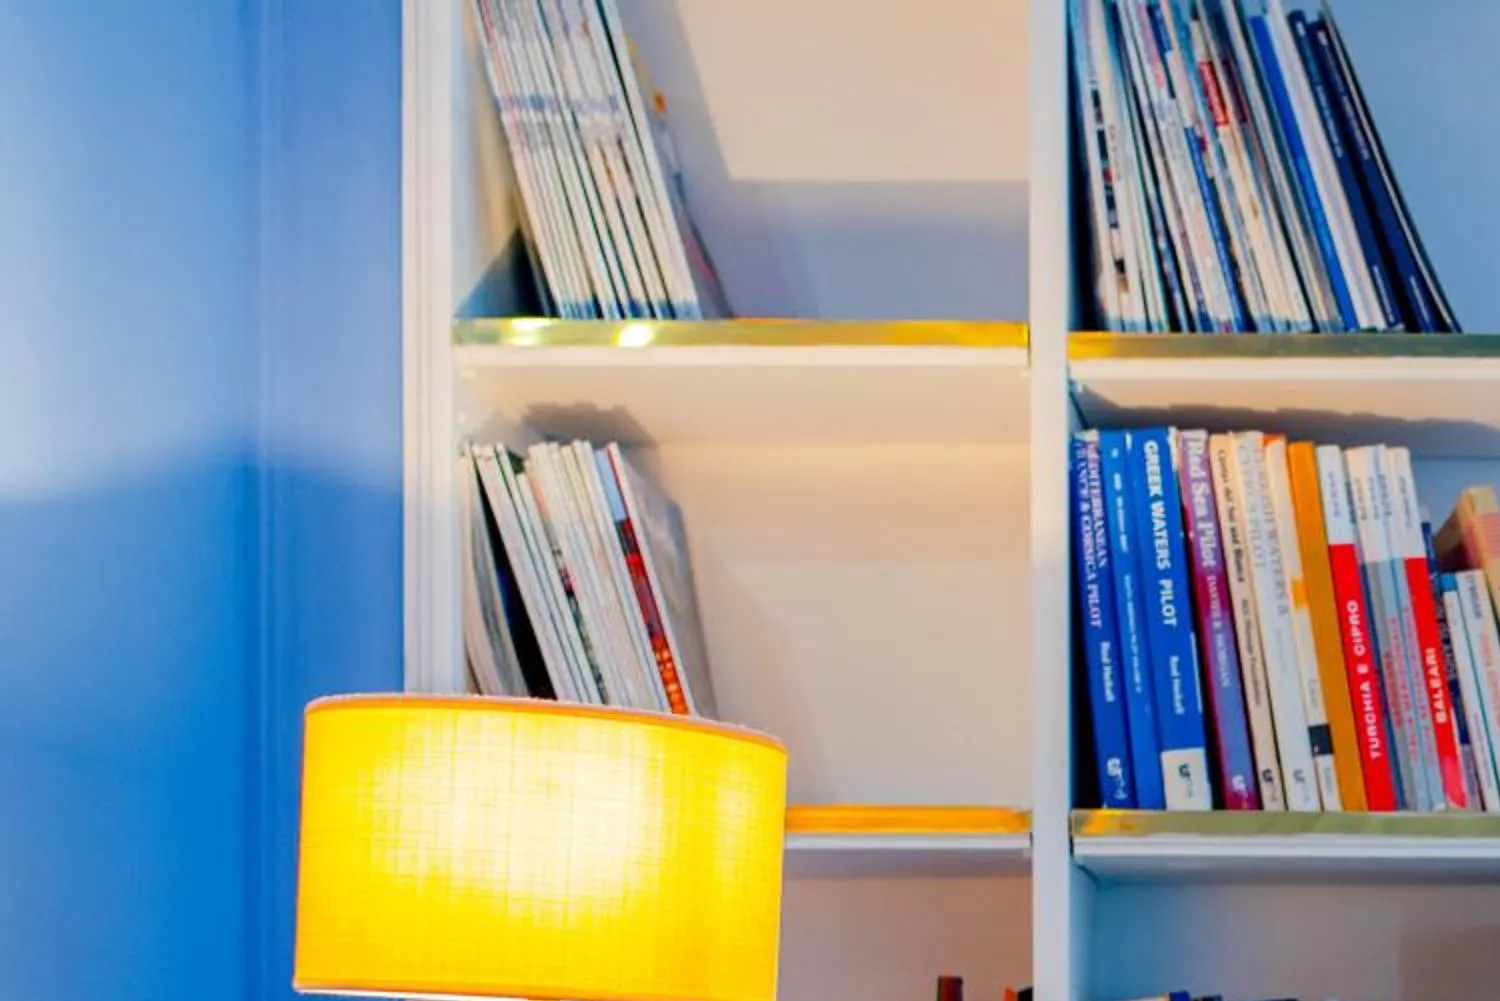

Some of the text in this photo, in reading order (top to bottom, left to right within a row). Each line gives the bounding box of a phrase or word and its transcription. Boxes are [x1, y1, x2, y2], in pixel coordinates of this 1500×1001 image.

[1184, 440, 1209, 481] Red
[1086, 442, 1108, 568] MEDITERRANEAN
[1142, 439, 1177, 627] GREEK WATERS PILOT
[1189, 481, 1212, 517] Sea
[1080, 515, 1097, 581] CORSICA
[1195, 519, 1221, 568] Pilot
[1264, 528, 1287, 601] WATERS
[1085, 583, 1102, 629] PILOT
[1346, 598, 1382, 760] TURCHIA E CIPRO
[1425, 646, 1447, 724] BALEARI
